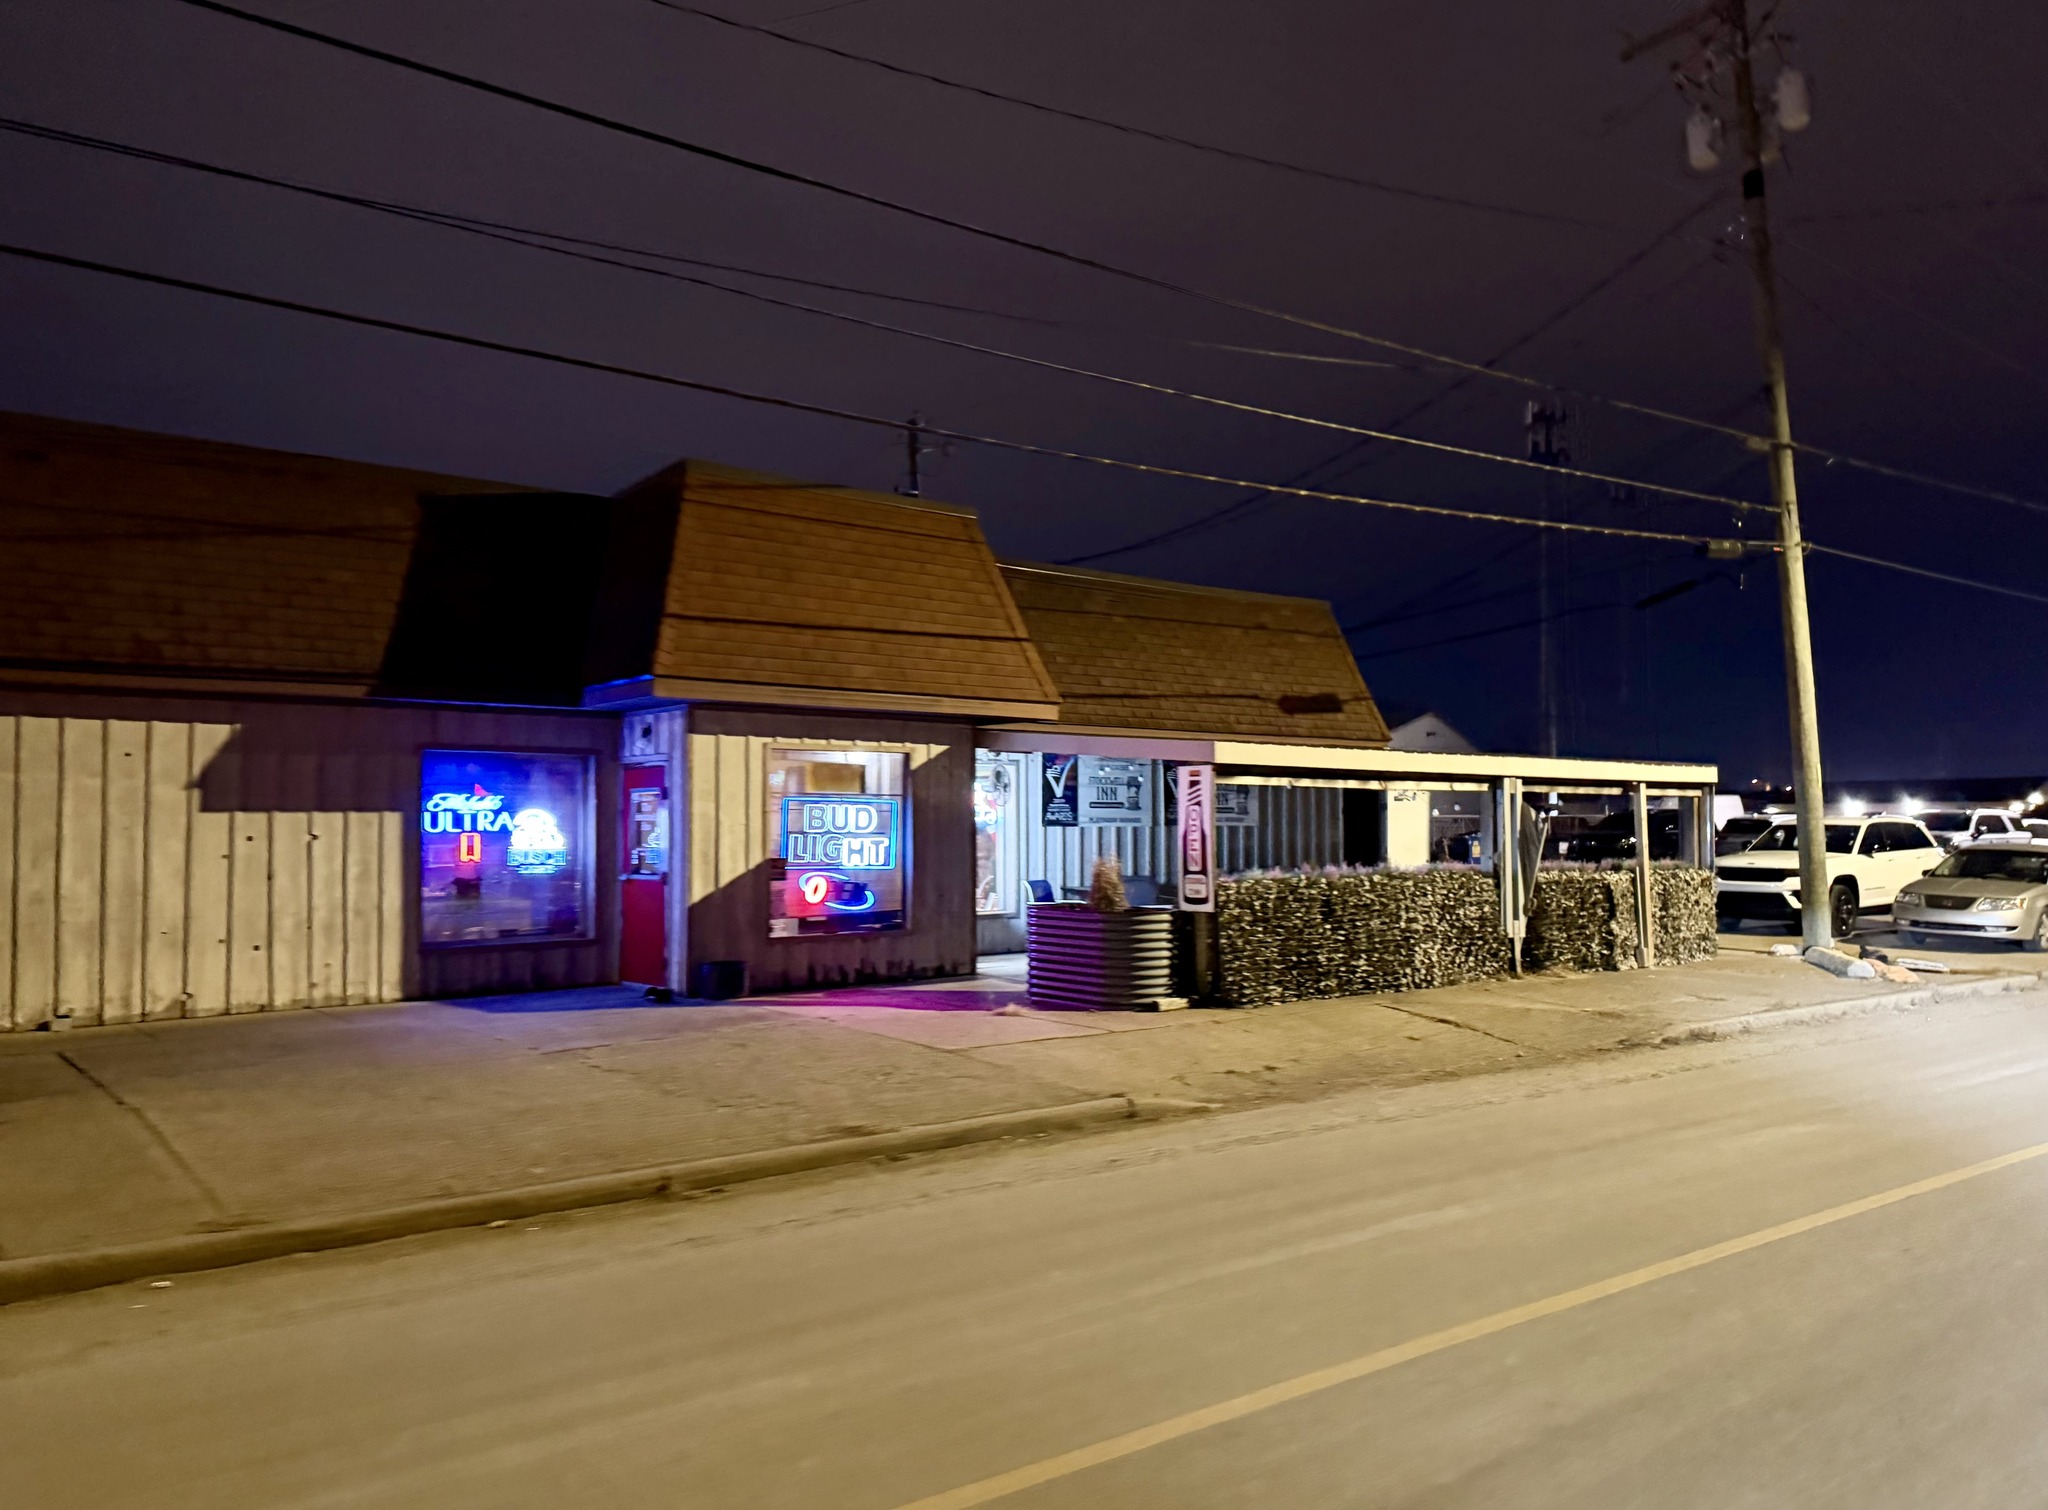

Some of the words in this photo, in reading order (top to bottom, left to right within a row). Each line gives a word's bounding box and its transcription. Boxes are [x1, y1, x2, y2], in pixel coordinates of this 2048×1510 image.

[1096, 786, 1118, 801] INN
[423, 811, 516, 833] ULTRA
[803, 804, 878, 833] BUD
[787, 834, 890, 867] LIGHT
